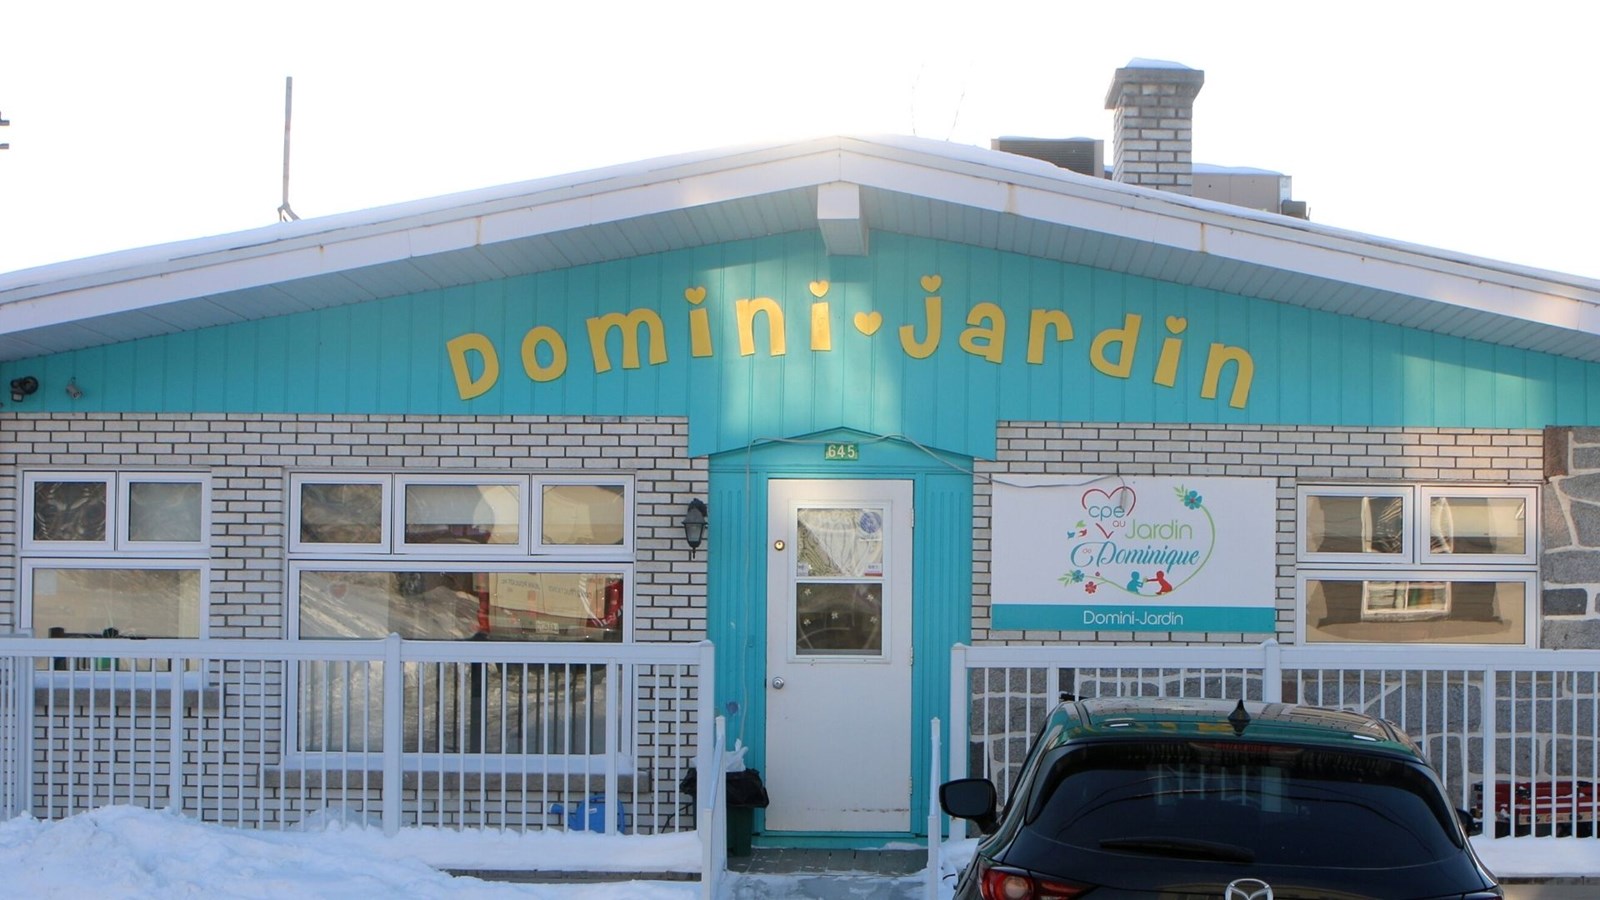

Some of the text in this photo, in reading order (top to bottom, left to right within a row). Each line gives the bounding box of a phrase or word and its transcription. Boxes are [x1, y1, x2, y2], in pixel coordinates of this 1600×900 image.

[445, 281, 833, 400] Domini
[828, 445, 855, 458] 645
[1088, 505, 1125, 521] cpe
[1112, 519, 1193, 540] au Jardin
[1071, 541, 1200, 574] Dominique
[1083, 610, 1183, 626] Domini-Jardin
